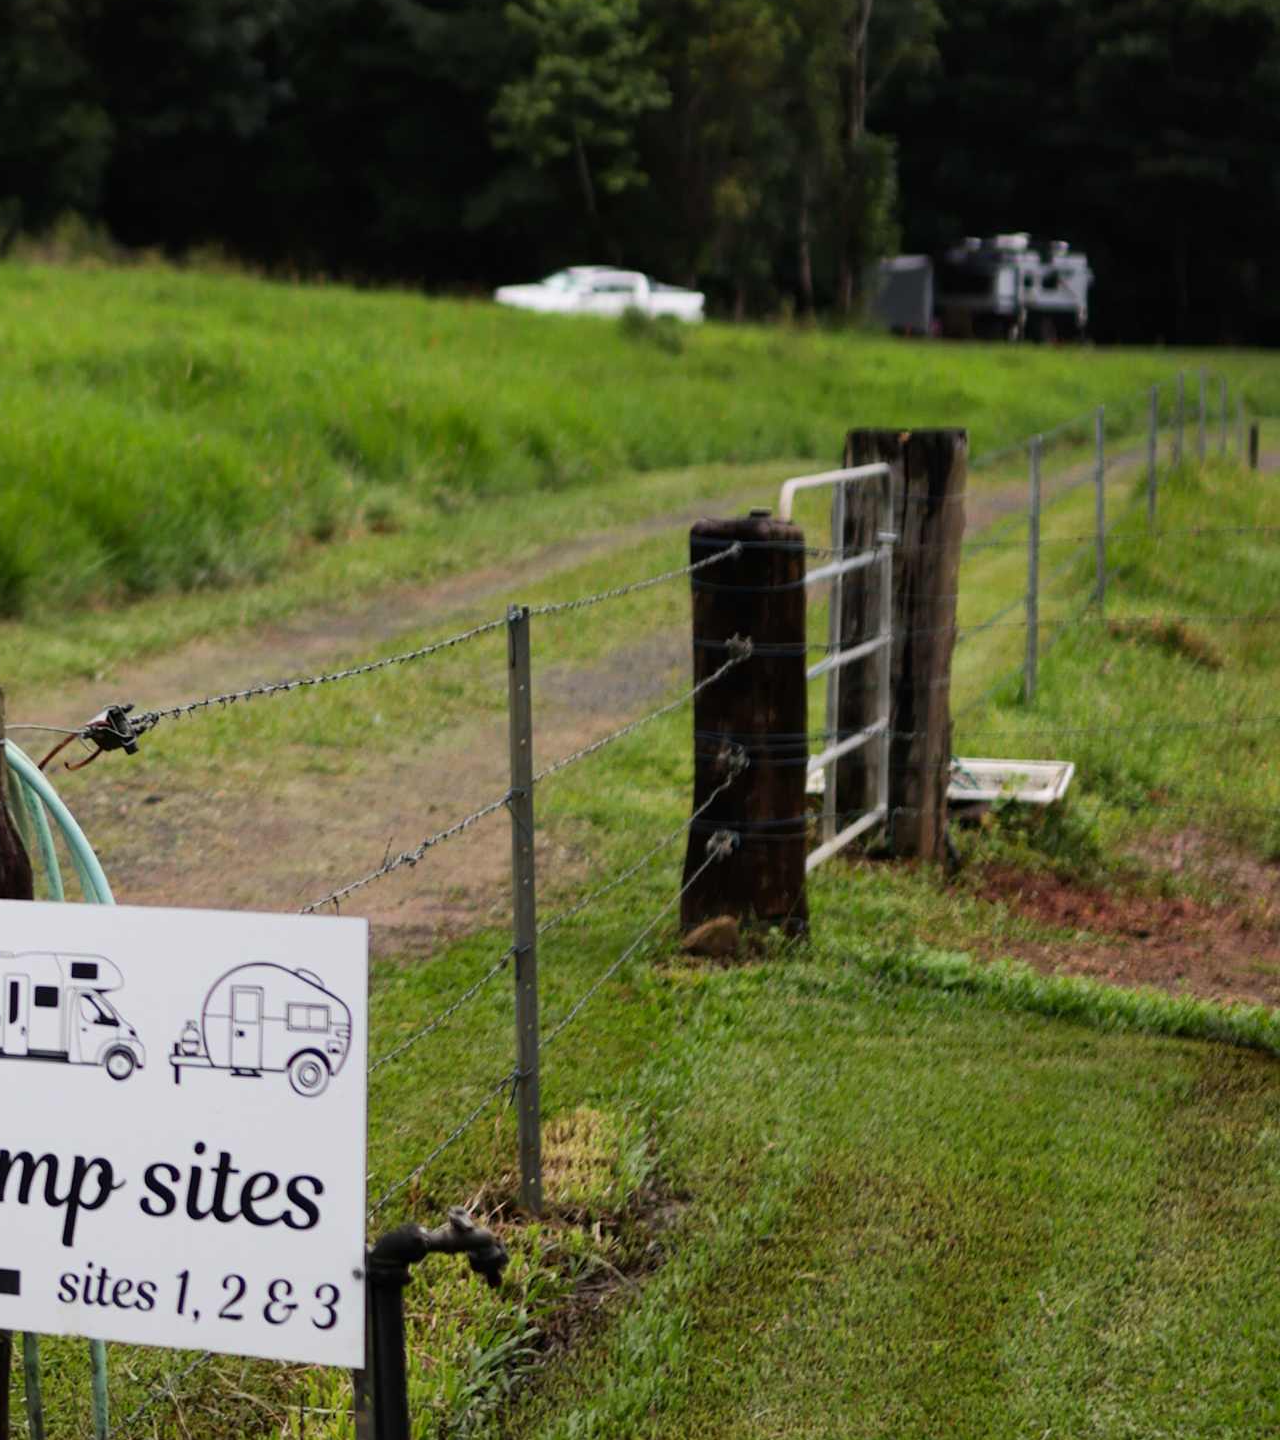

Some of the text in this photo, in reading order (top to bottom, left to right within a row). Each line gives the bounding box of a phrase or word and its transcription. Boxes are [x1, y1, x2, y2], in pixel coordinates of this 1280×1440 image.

[139, 1141, 325, 1230] sites
[57, 1261, 340, 1329] sites 1, 2 & 3
